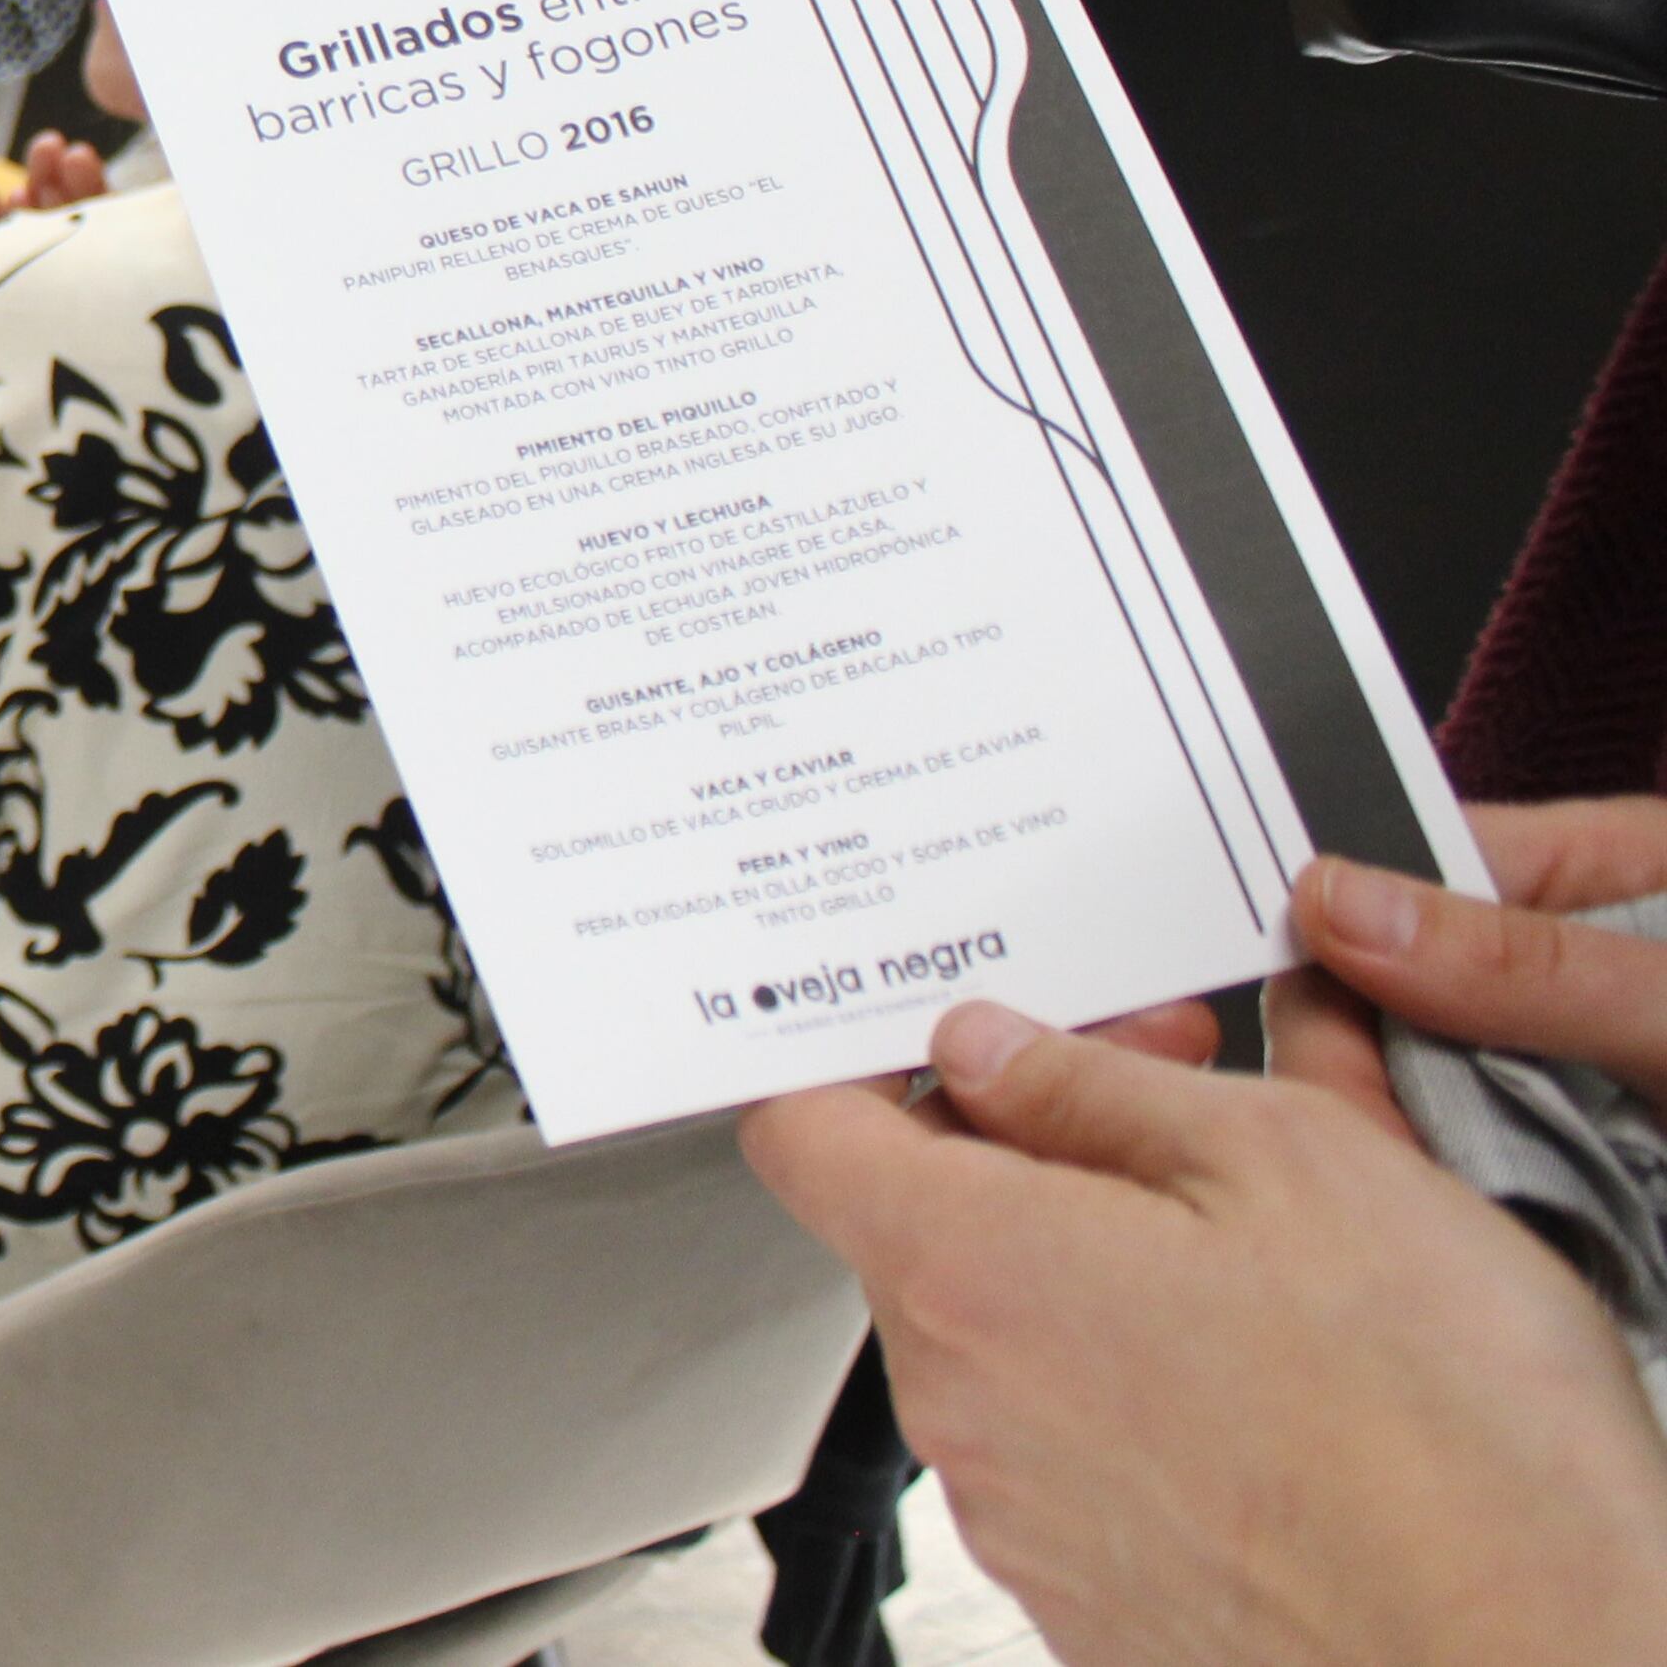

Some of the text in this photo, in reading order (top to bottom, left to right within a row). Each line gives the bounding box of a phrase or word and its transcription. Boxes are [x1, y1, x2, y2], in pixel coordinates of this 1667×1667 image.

[246, 2, 748, 143] barricas y fogones
[278, 3, 524, 79] Grillados
[401, 105, 655, 187] GRILLO 2016
[342, 259, 436, 291] PANIPURI
[438, 237, 532, 270] RELLENO
[534, 229, 565, 249] DE
[567, 212, 639, 241] CREMA
[640, 203, 671, 223] DE
[674, 185, 745, 215] QUESO
[419, 174, 689, 249] QUESO DE VACA DE SAHUN
[356, 360, 439, 389] TARTAR
[440, 352, 472, 373] DE
[473, 325, 596, 365] SECALLONA
[598, 316, 629, 337] DE
[630, 302, 684, 329] BUEY
[689, 294, 720, 315] DE
[402, 296, 818, 407] GANADERÍA PIRI TAURUS Y MANTEQUILLA
[415, 257, 764, 352] SECALLONA, MANTEQUILLA Y VINO
[442, 327, 794, 423] MONTADA CON VINO TINTO GRILLO
[394, 479, 492, 512] PIMIENTO
[494, 471, 537, 492] DEL
[538, 447, 632, 482] PIQUILLO
[757, 383, 881, 429] CONFITADO
[883, 378, 897, 393] Y
[516, 390, 757, 460] PIMIENTO DEL PIQUILLO
[410, 498, 523, 536] GLASEADO
[525, 491, 555, 511] EN
[557, 480, 605, 504] UNA
[608, 463, 681, 492] CREMA
[683, 439, 773, 474] INGLESA
[774, 430, 806, 451] DE
[807, 421, 837, 443] SU
[578, 494, 772, 553] HUEVO Y LECHUGA
[443, 477, 926, 608] HUEVO ECOLÓGICO FRITO DE CASTILLAZUELO Y
[496, 578, 646, 625] EMULSIONADO
[650, 566, 698, 591] CON
[699, 542, 794, 578] VINAGRE
[796, 533, 827, 555] DE
[454, 525, 962, 660] ACOMPAÑADO DE LECHUGA JOVEN HIDROPÓNICA
[644, 625, 675, 647] DE
[490, 623, 1003, 761] GUISANTE BRASA Y COLÁGENO DE BACALAO TIPO
[586, 630, 882, 714] GUISANTE, AJO Y COLÁGENO
[530, 825, 648, 864] SOLOMILLO
[650, 817, 680, 839] DE
[682, 805, 744, 831] VACA
[745, 786, 821, 818] CRUDO
[824, 780, 838, 796] Y
[844, 761, 921, 794] CREMA
[923, 751, 956, 774] DE
[690, 750, 855, 801] VACA Y CAVIAR
[573, 913, 630, 937] PERA
[632, 893, 729, 927] OXIDADA
[730, 886, 761, 907] EN
[762, 872, 820, 900] OLLA
[890, 850, 905, 867] Y
[910, 834, 973, 864] SOPA
[974, 822, 1007, 847] DE
[1008, 806, 1068, 836] VINO
[736, 832, 869, 874] PERA Y VINO
[754, 883, 896, 927] TINTO GRILLO
[693, 990, 738, 1024] la
[752, 966, 863, 1012] oveja
[877, 930, 1007, 985] negra
